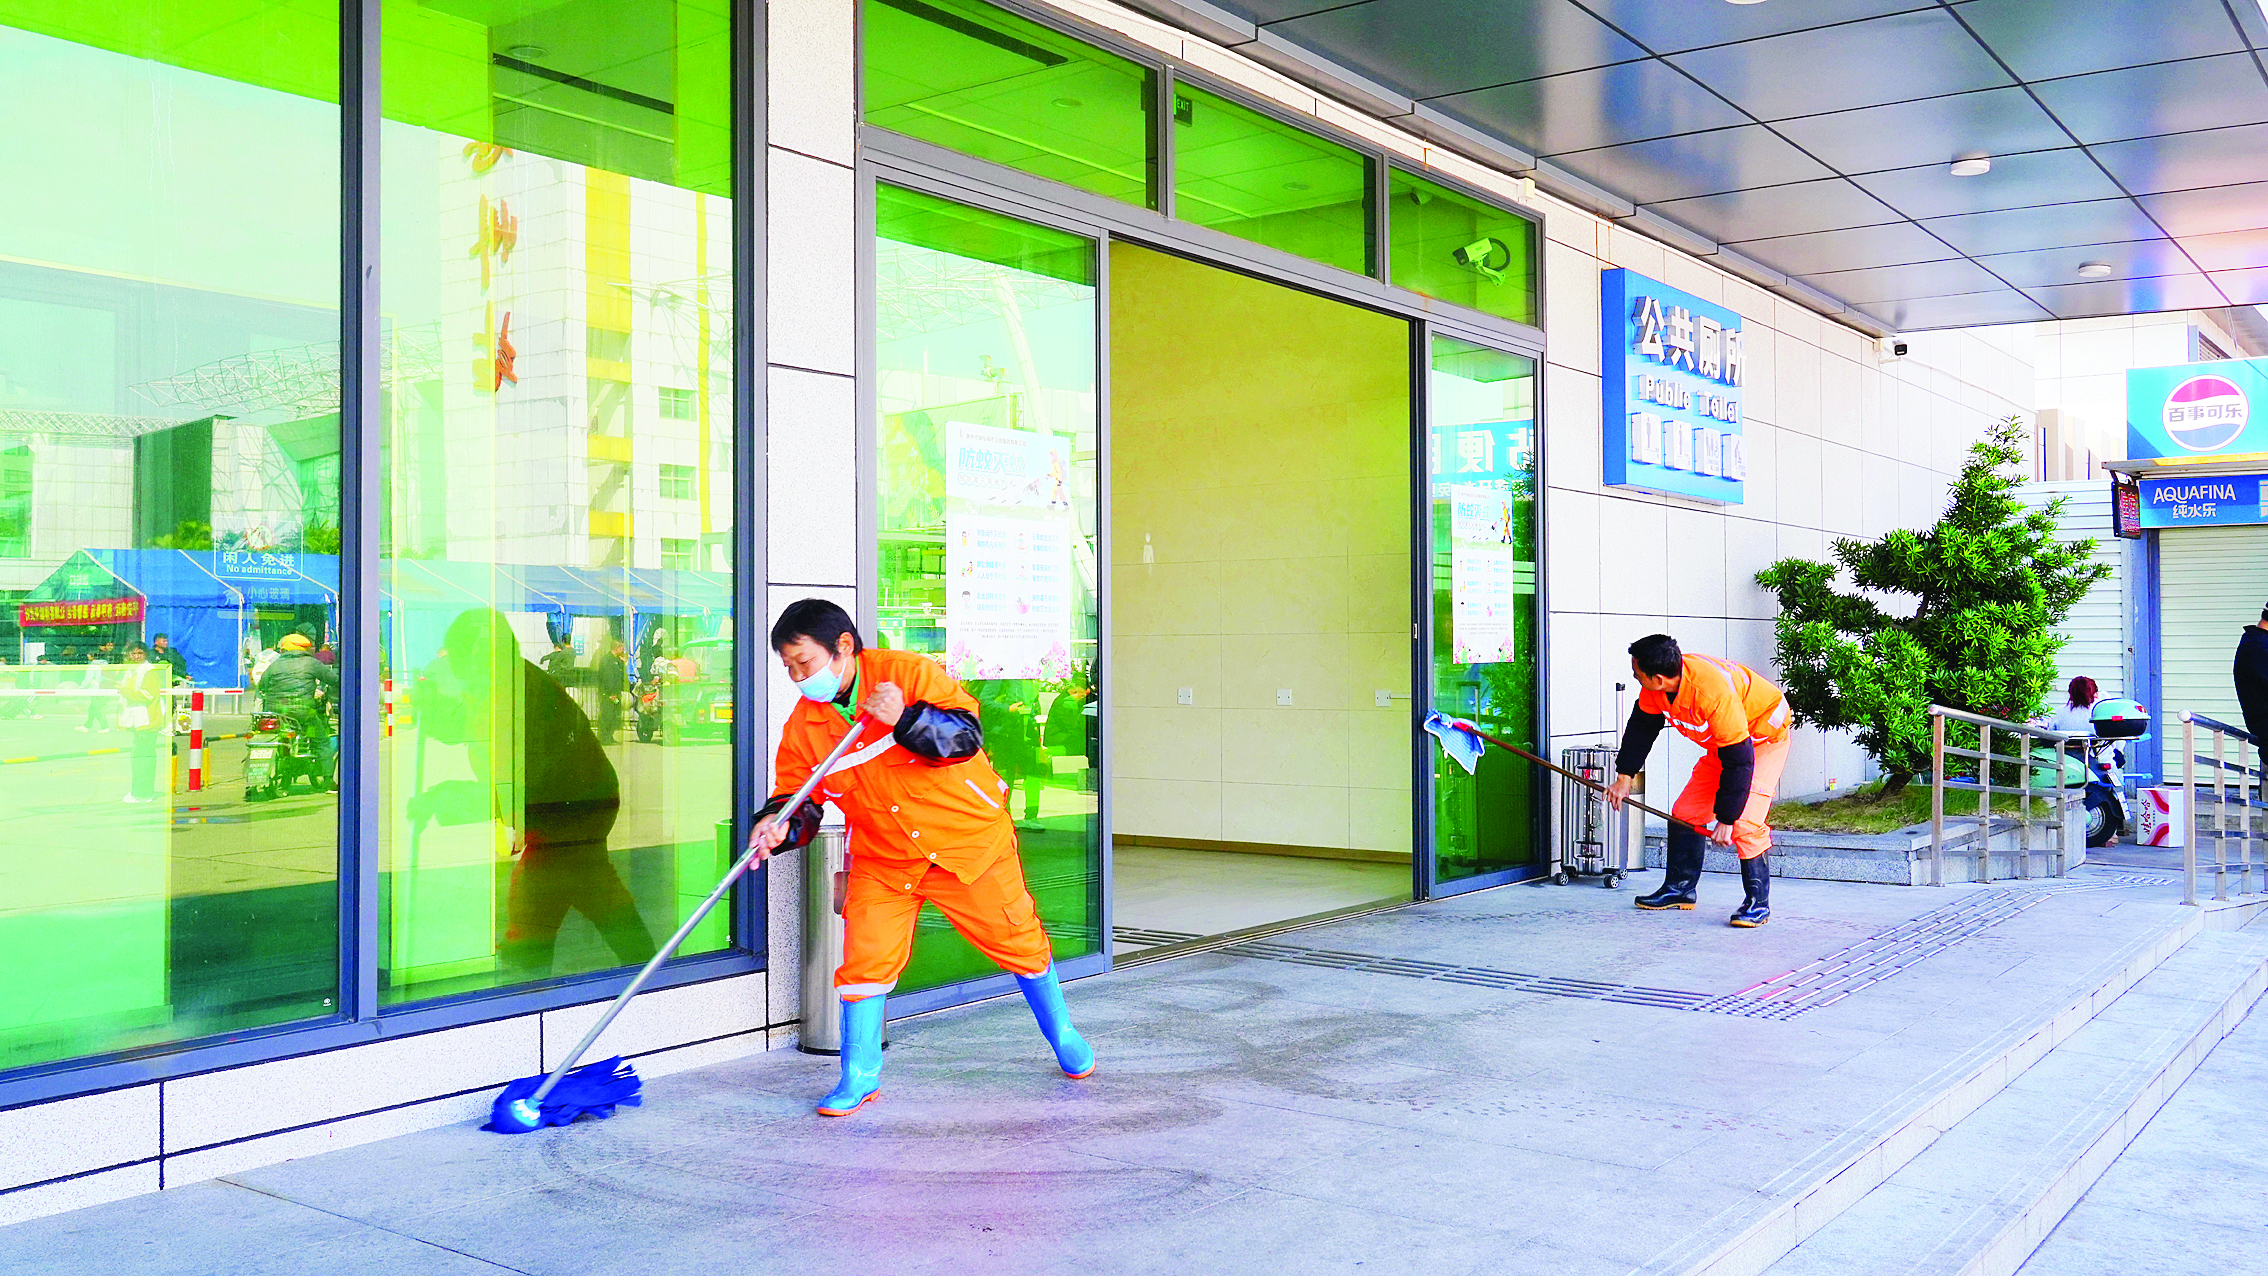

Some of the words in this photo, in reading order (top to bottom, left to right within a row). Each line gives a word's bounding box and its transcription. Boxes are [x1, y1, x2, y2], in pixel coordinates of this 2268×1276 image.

[1177, 99, 1189, 111] EXIT
[1632, 296, 1746, 387] 公共厕所
[1640, 374, 1691, 410] Public
[2168, 403, 2243, 423] 百事可乐
[958, 447, 1024, 475] 防蚊灭蚊
[2153, 484, 2237, 505] AQUAFINA
[2172, 503, 2217, 519] 纯水乐
[223, 551, 294, 567] 闲人免进
[226, 564, 239, 573] No
[241, 565, 292, 575] admittance
